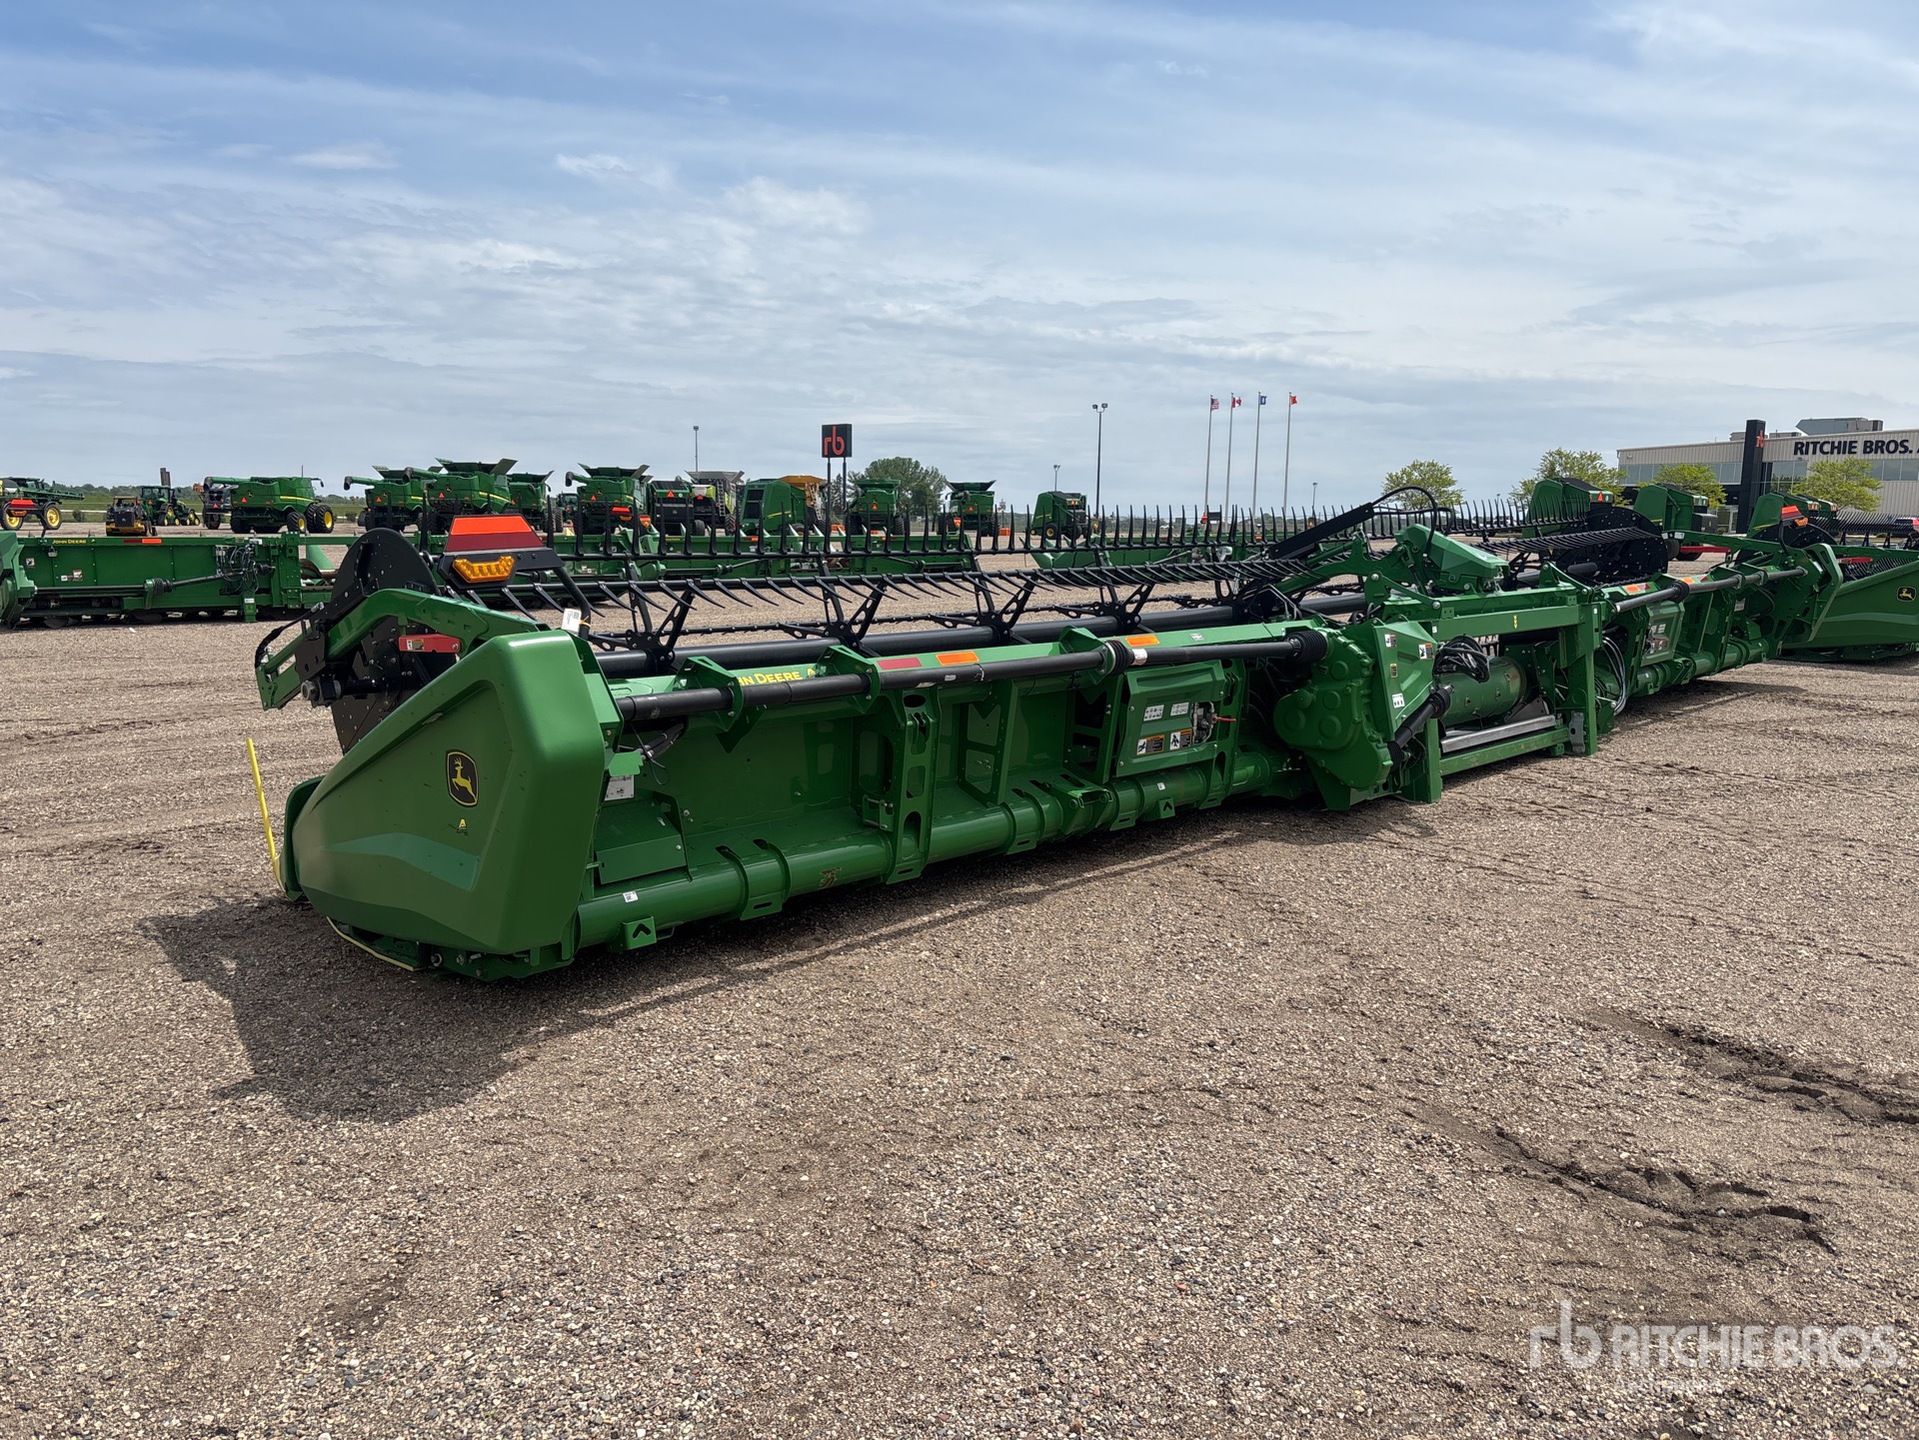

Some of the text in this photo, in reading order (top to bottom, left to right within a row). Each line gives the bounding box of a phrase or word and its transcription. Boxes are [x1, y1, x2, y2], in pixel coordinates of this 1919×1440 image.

[1793, 440, 1858, 455] RITCHIE
[1863, 439, 1913, 454] BROS.
[754, 671, 803, 684] DEERE
